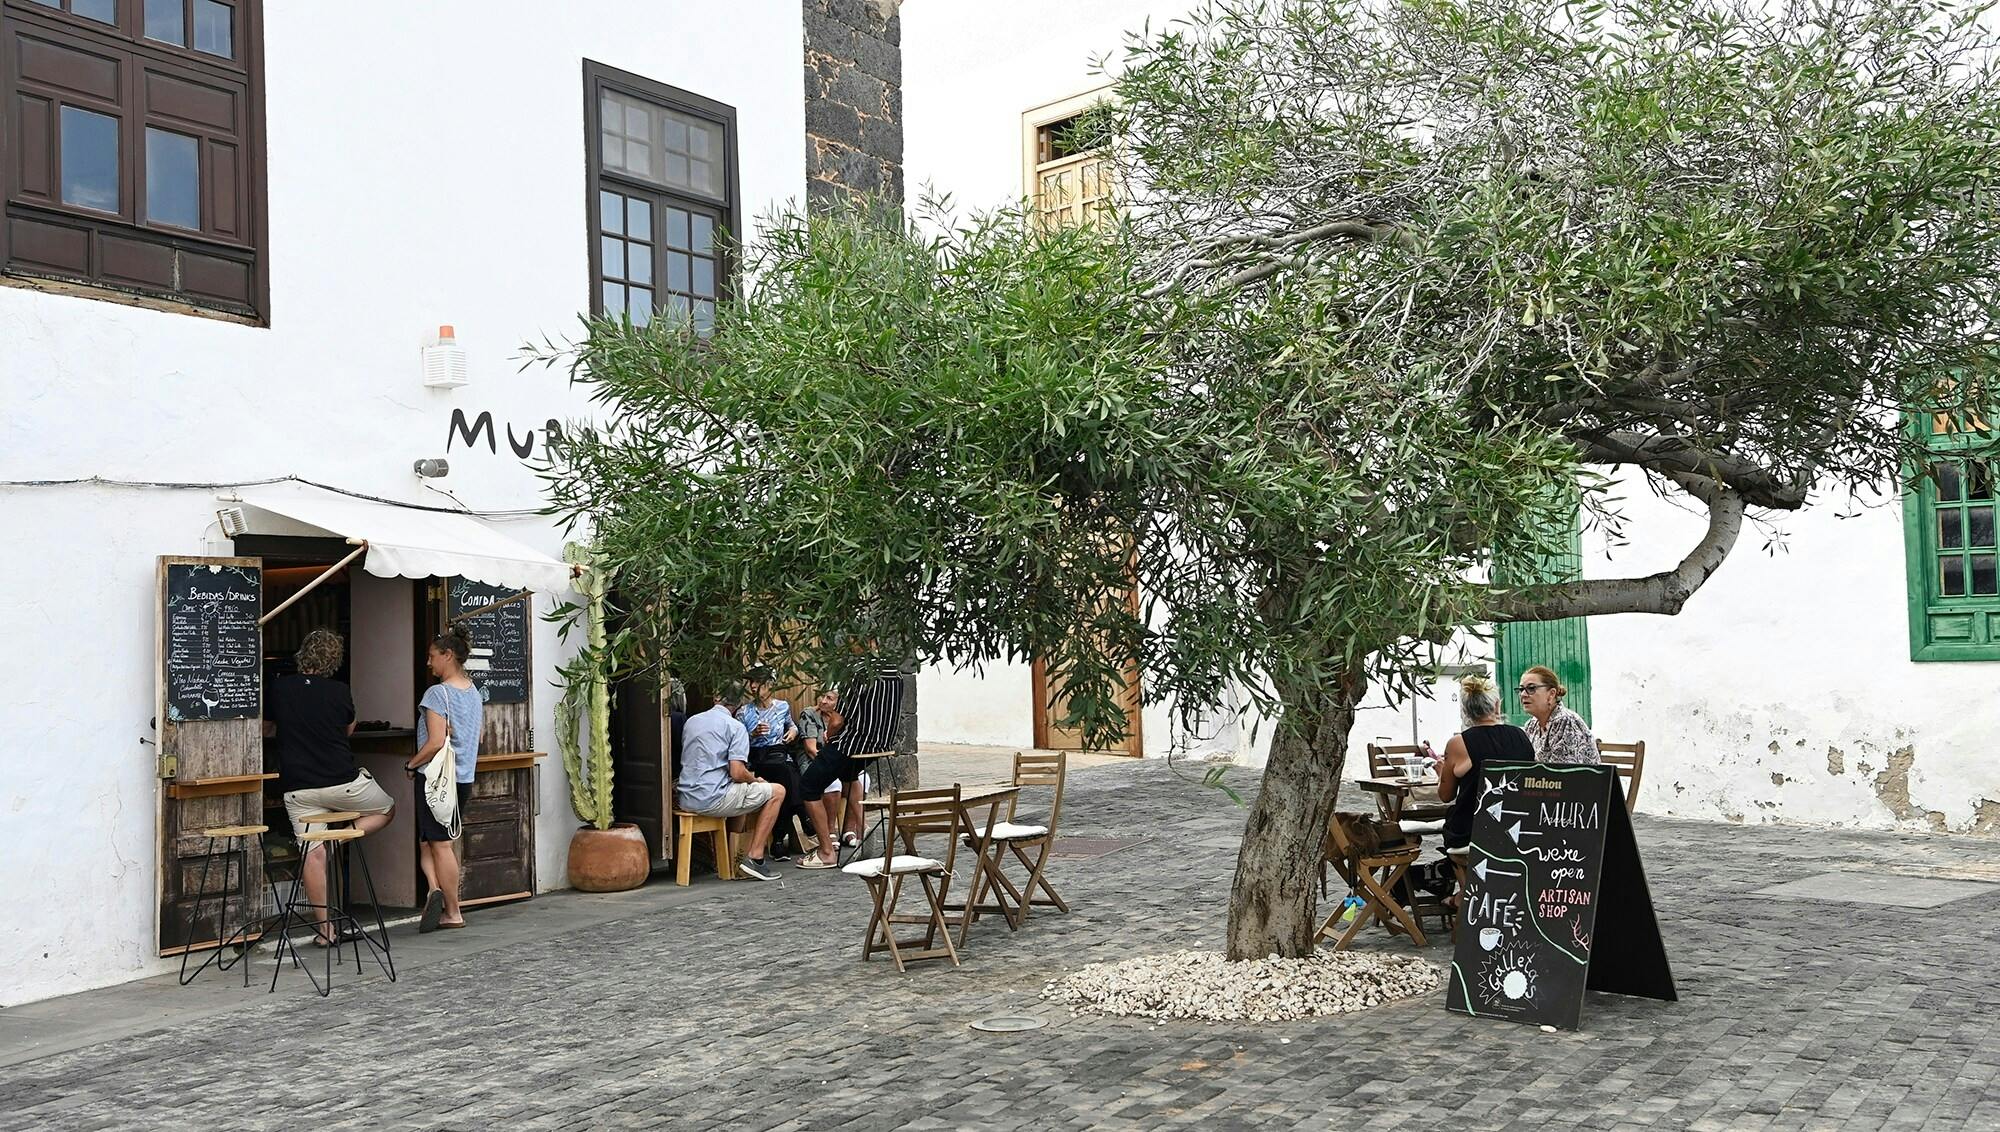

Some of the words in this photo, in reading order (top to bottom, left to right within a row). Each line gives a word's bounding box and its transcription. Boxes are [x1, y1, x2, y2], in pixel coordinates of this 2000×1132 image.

[447, 408, 598, 464] MUR
[461, 591, 495, 606] COMIDA
[1524, 777, 1562, 790] Mahou
[1539, 802, 1598, 829] MURA
[1551, 868, 1585, 888] open
[1538, 889, 1591, 905] ARTISAN
[1467, 892, 1517, 927] CAFÉ
[1538, 904, 1568, 918] SHOP
[1488, 949, 1538, 999] Galletas
